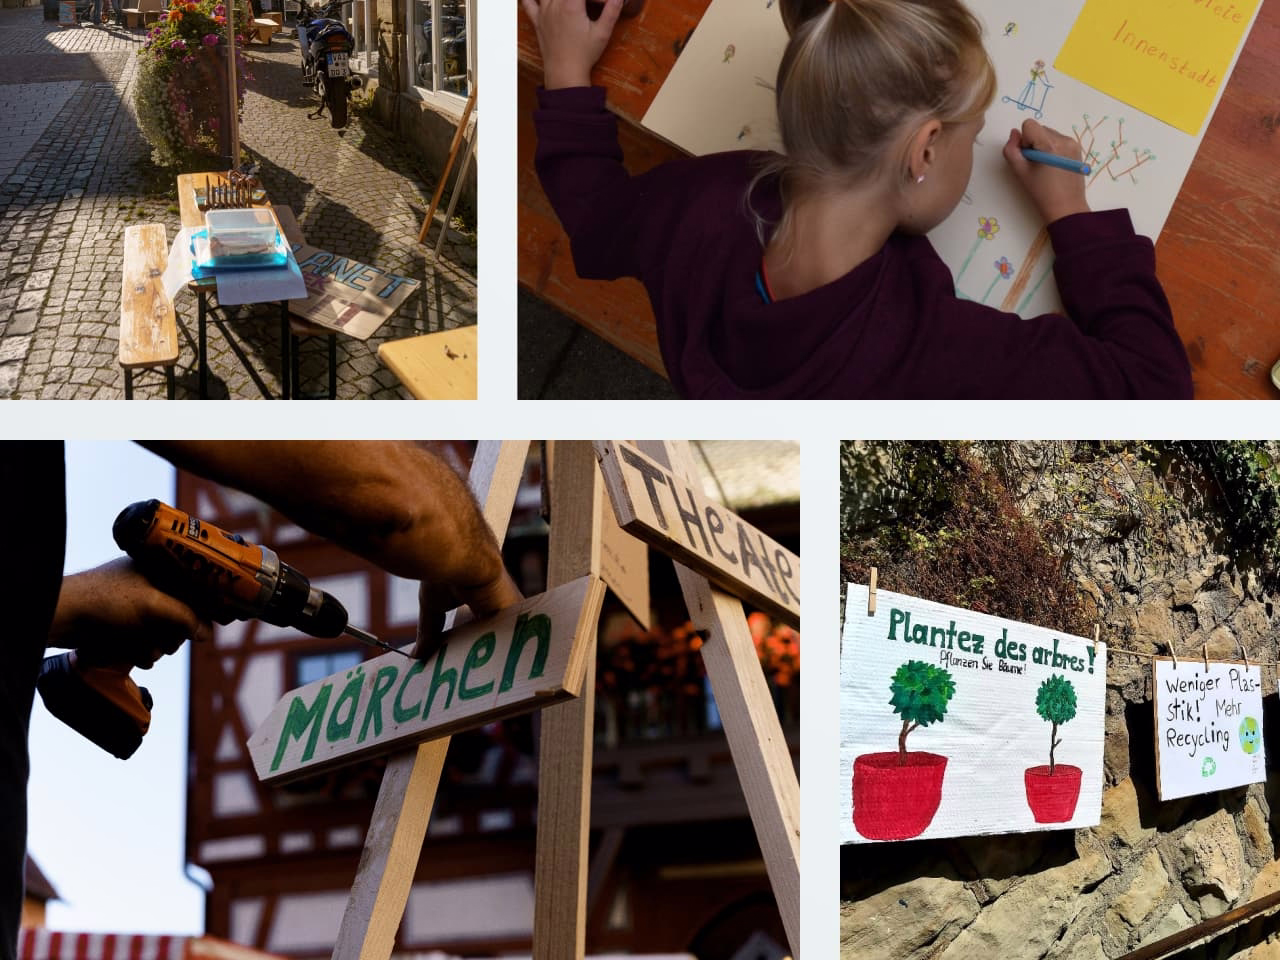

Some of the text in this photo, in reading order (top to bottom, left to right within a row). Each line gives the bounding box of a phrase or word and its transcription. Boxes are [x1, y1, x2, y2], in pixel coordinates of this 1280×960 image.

[1112, 19, 1217, 88] Innenstadt
[887, 607, 985, 654] Plantez
[994, 628, 1027, 662] des
[939, 649, 979, 669] Pflanzen
[981, 656, 993, 671] Sie
[1215, 697, 1242, 718] Mehr
[1166, 721, 1230, 758] Recycling
